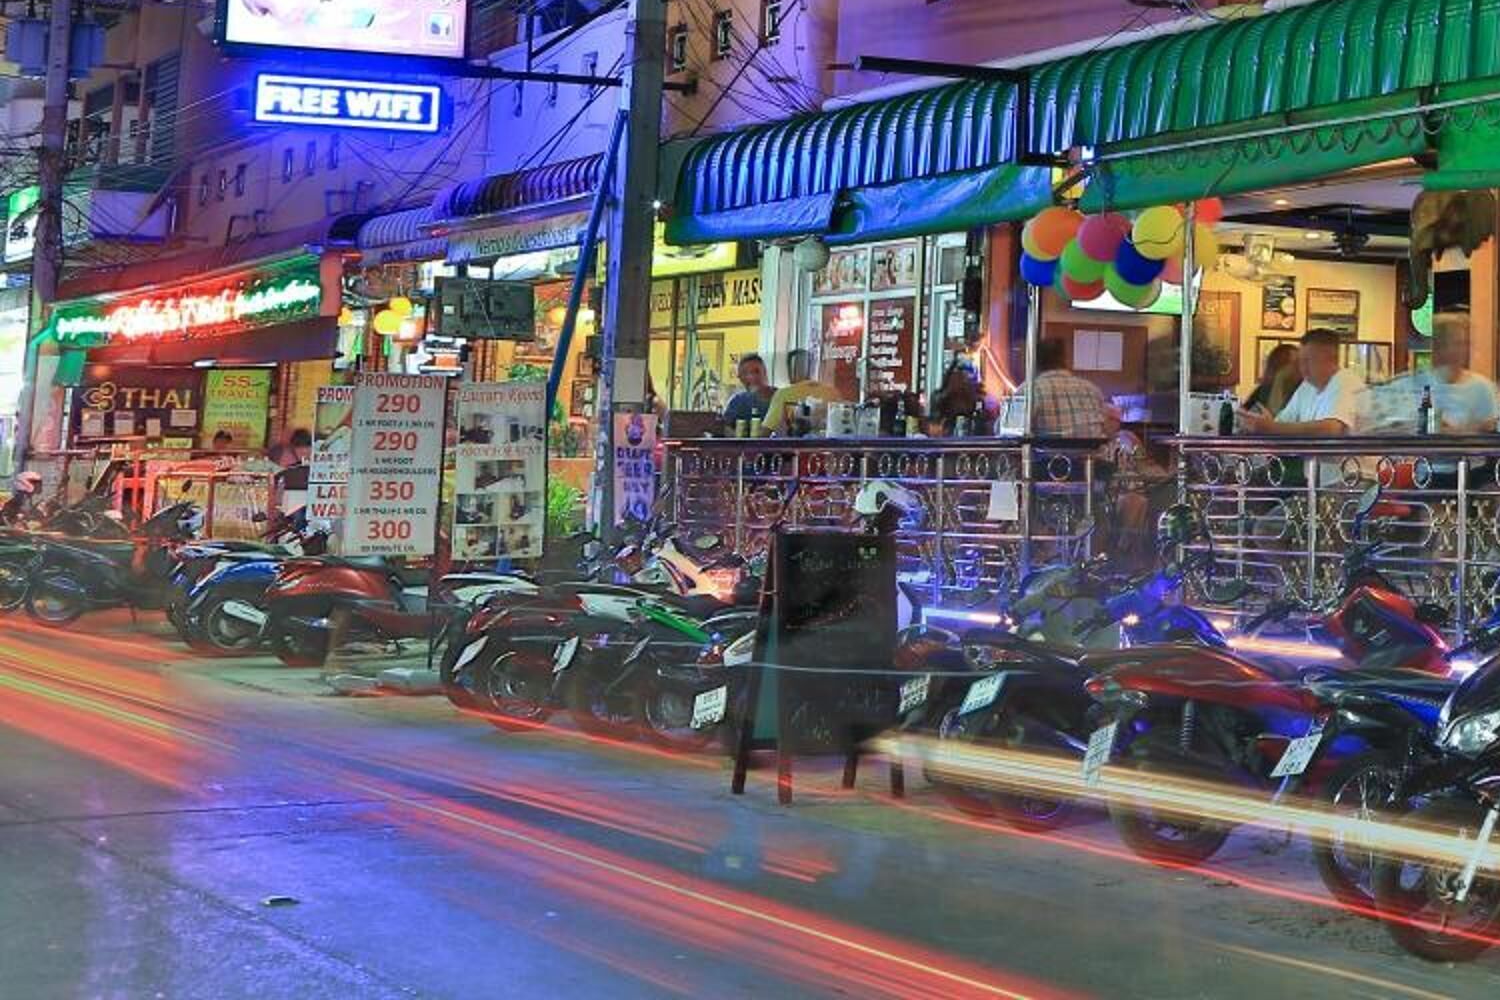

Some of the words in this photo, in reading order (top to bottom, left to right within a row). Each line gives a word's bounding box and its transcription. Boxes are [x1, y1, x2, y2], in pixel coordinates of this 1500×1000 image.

[265, 86, 341, 116] FREE
[346, 91, 422, 121] WIFI
[353, 373, 444, 389] PROMOTION
[120, 388, 192, 409] THAI
[376, 394, 420, 413] 290
[373, 431, 418, 451] 290
[369, 481, 415, 501] 350
[367, 520, 412, 540] 300
